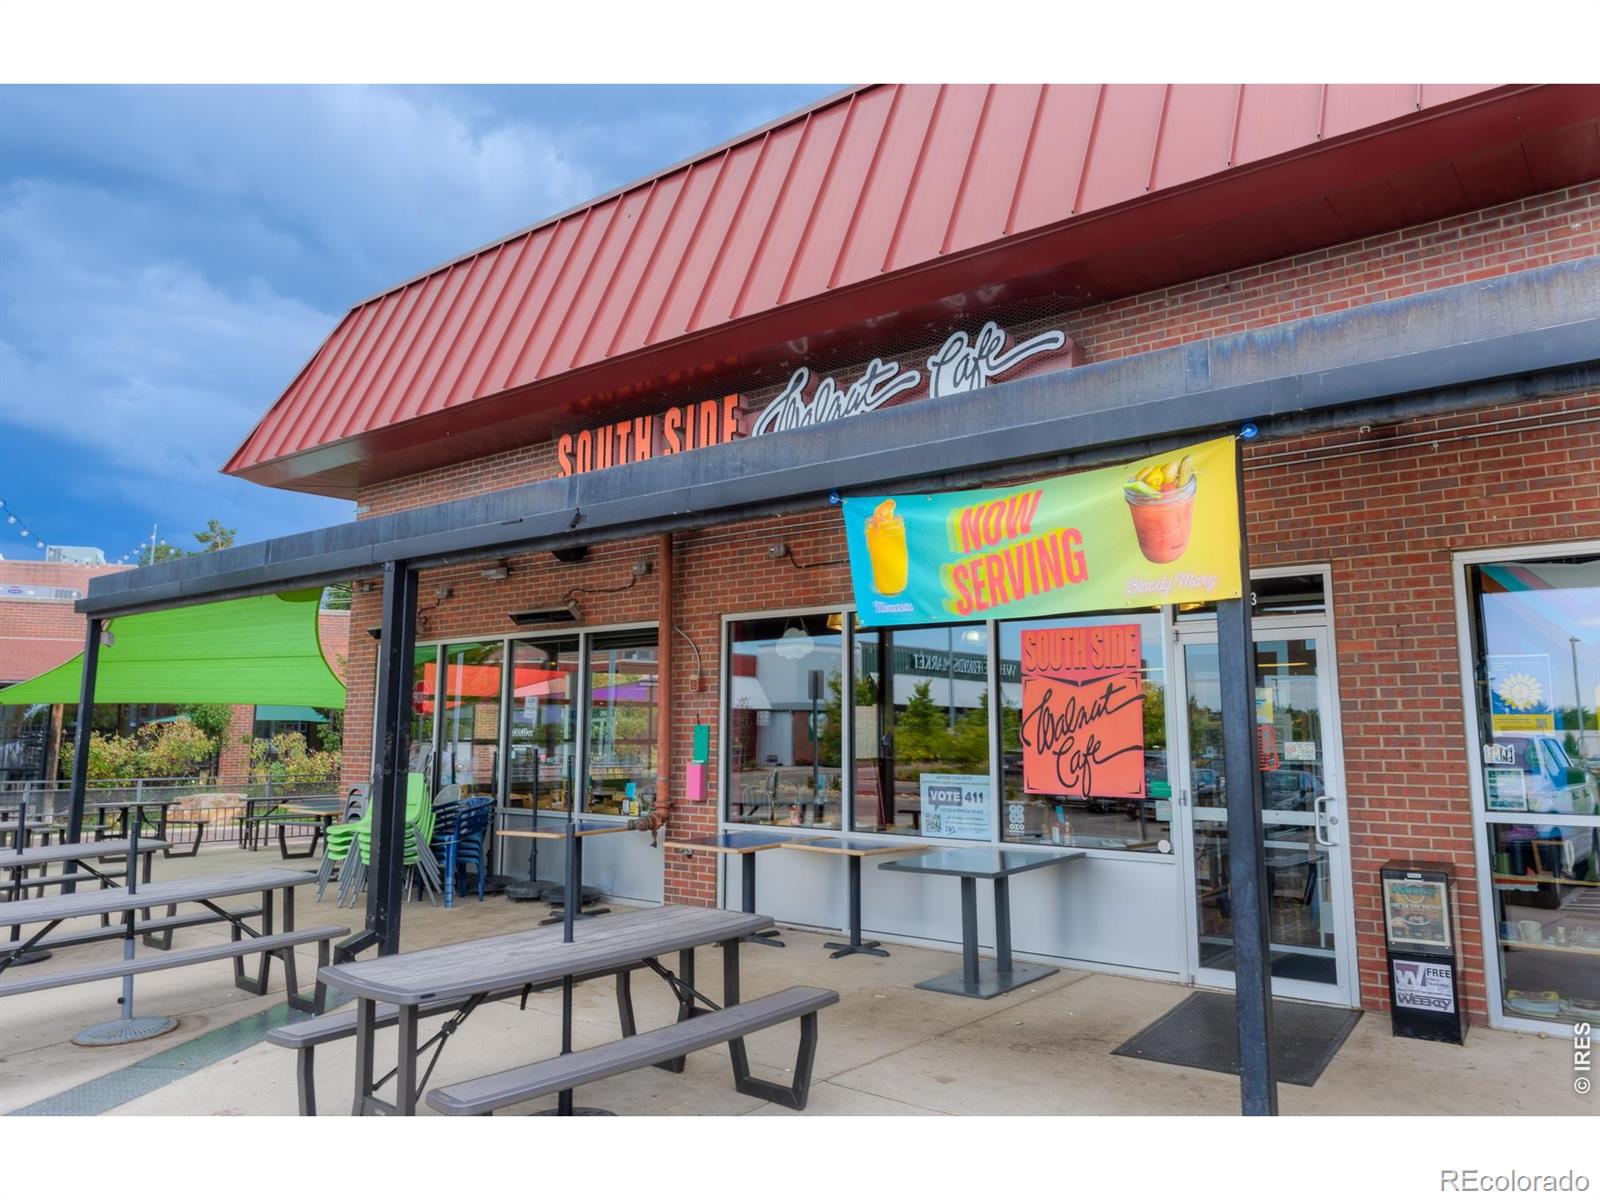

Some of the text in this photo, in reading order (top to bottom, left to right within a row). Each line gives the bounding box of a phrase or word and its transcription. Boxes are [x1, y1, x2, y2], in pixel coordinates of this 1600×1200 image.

[557, 415, 652, 480] SOUTH
[663, 393, 740, 456] SIDE
[955, 489, 1044, 554] NOW
[948, 527, 1089, 617] SERVING
[1250, 591, 1257, 606] 3
[1024, 625, 1137, 671] SOUTH SIDE
[1021, 682, 1146, 755] Walnut
[929, 790, 984, 804] VOTE 411
[1053, 734, 1143, 798] Cafe
[1426, 967, 1451, 979] FREE
